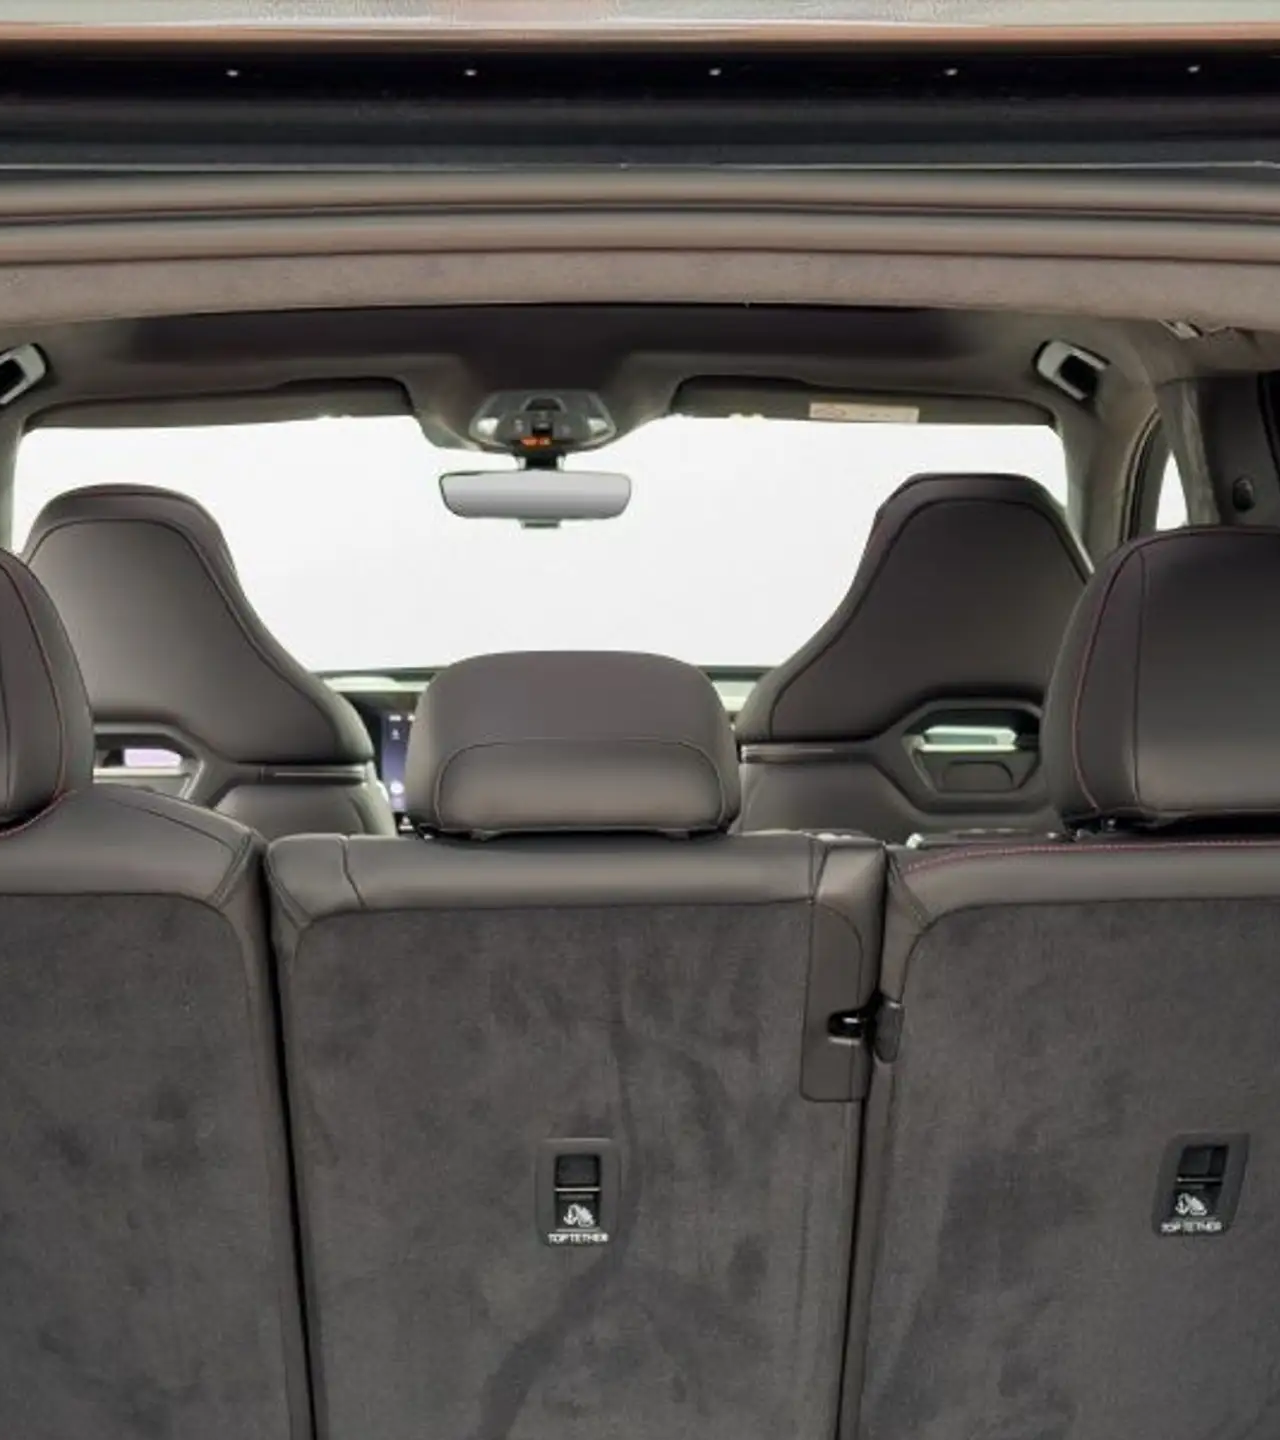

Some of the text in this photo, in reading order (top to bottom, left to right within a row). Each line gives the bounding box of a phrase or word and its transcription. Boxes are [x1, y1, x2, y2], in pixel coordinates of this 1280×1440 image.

[1161, 1222, 1181, 1232] TOP
[547, 1232, 609, 1243] TOP TETHER
